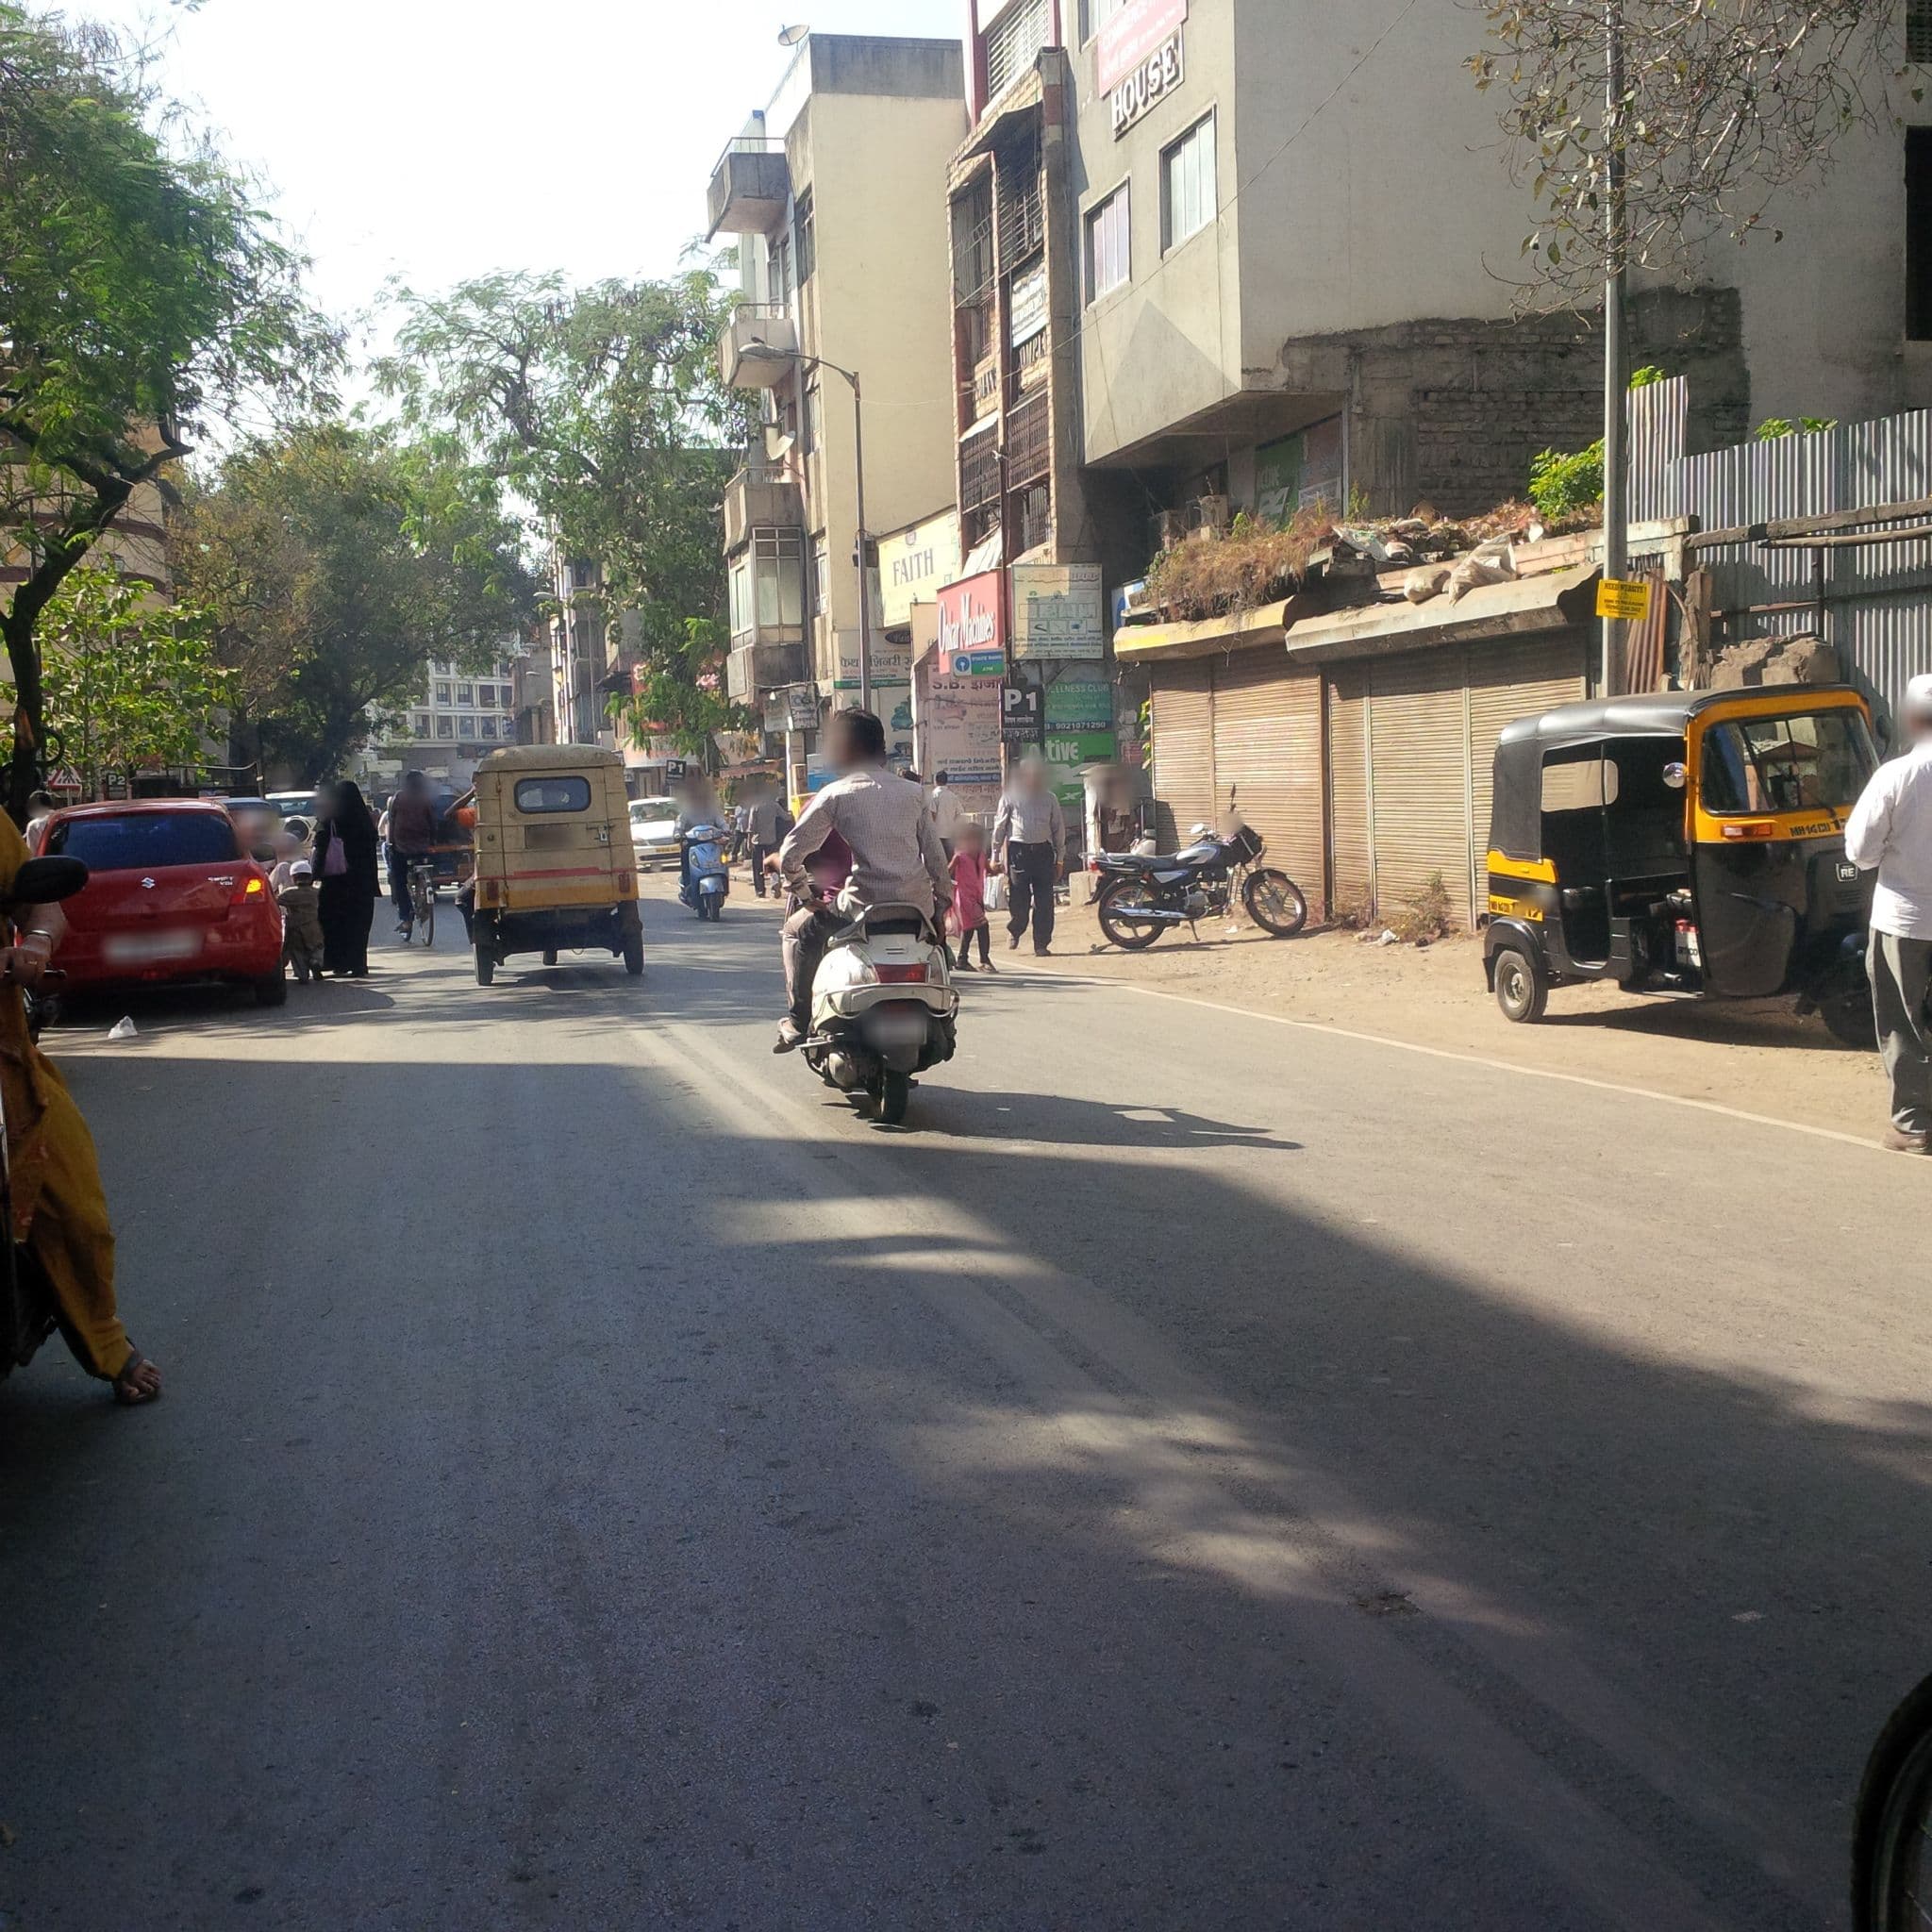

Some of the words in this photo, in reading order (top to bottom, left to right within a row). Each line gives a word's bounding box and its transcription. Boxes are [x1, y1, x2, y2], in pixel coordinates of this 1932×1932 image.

[1111, 37, 1177, 131] HOUSE
[892, 548, 934, 587] FAITH
[1004, 688, 1038, 712] P1
[667, 762, 684, 774] P1
[108, 774, 126, 786] P2
[1840, 867, 1855, 878] RE
